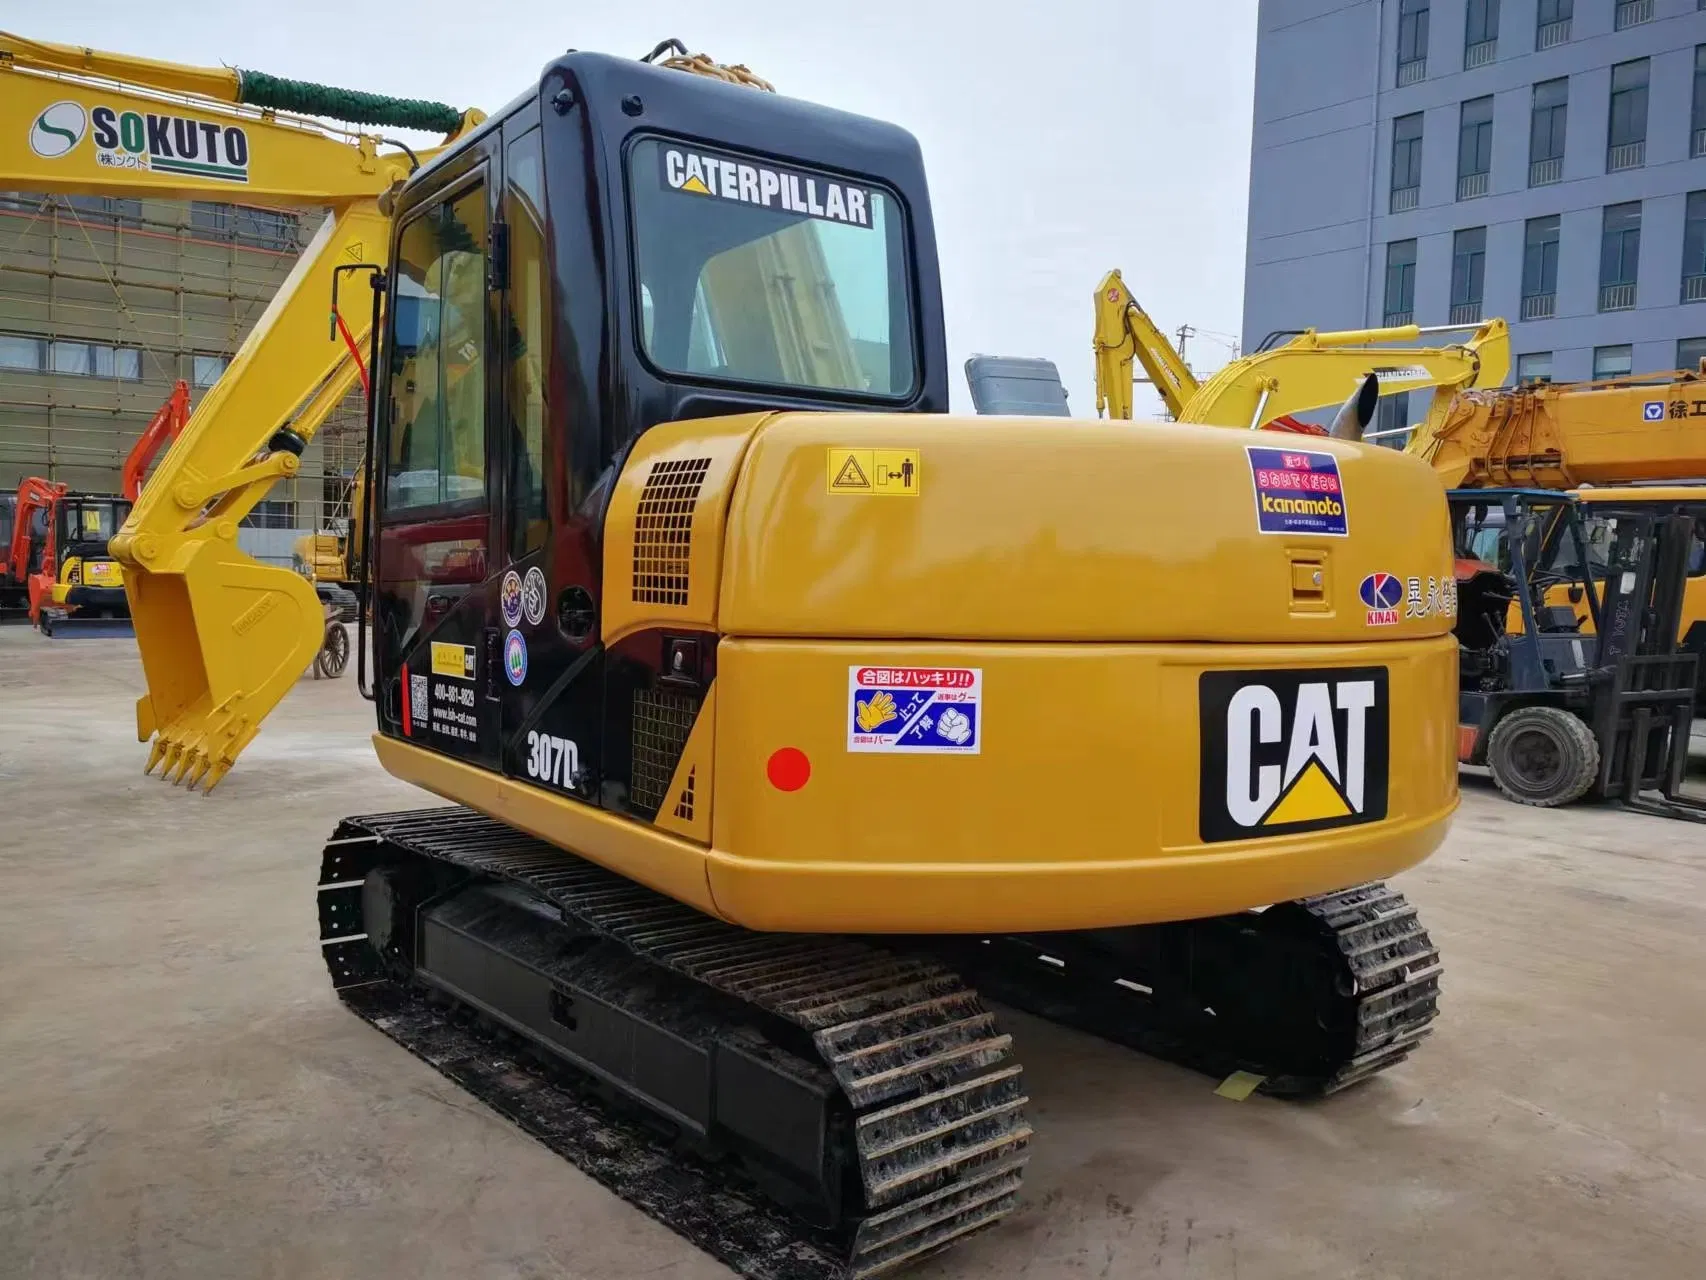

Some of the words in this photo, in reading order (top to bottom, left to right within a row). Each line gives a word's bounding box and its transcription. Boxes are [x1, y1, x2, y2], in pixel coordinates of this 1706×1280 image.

[92, 107, 248, 166] SOKUTO
[666, 150, 867, 225] CATERPILLAR
[1261, 493, 1342, 516] kanamoto
[1367, 610, 1398, 625] KINAN
[527, 729, 579, 790] 307D
[1226, 681, 1376, 827] CAT
